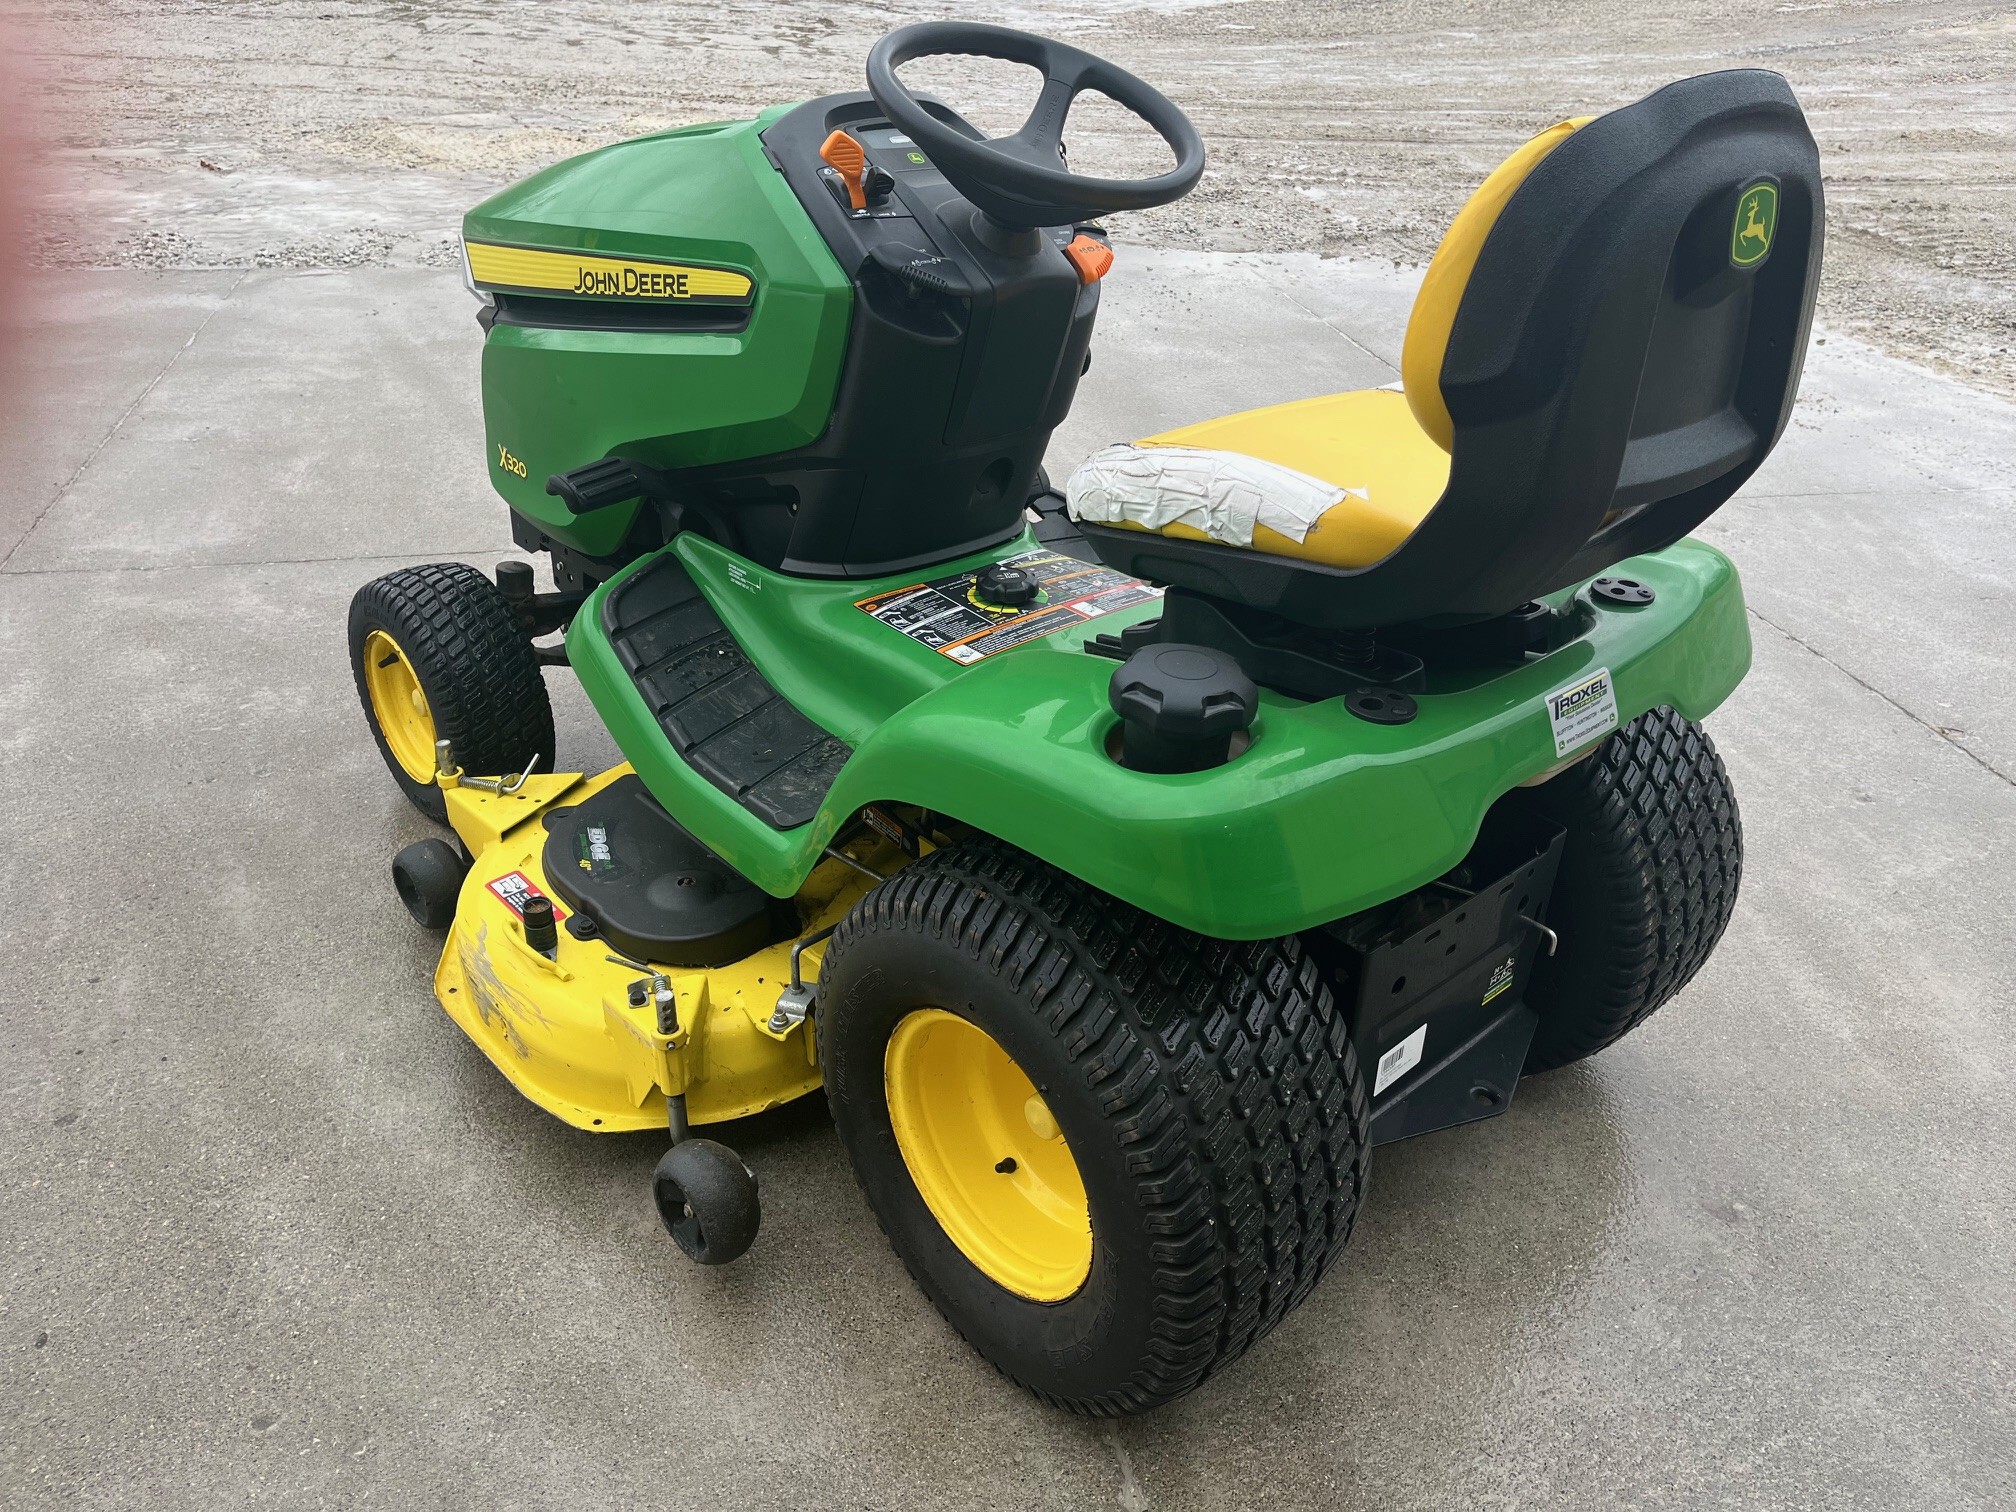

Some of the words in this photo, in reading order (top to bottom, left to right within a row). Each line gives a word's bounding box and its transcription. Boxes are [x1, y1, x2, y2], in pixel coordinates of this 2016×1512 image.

[574, 266, 621, 296] JOHN
[623, 268, 691, 298] DEERE
[498, 443, 527, 478] X320
[1549, 679, 1607, 721] TROXEL
[1563, 690, 1604, 716] EQUIPMENT
[587, 826, 611, 862] EDGE
